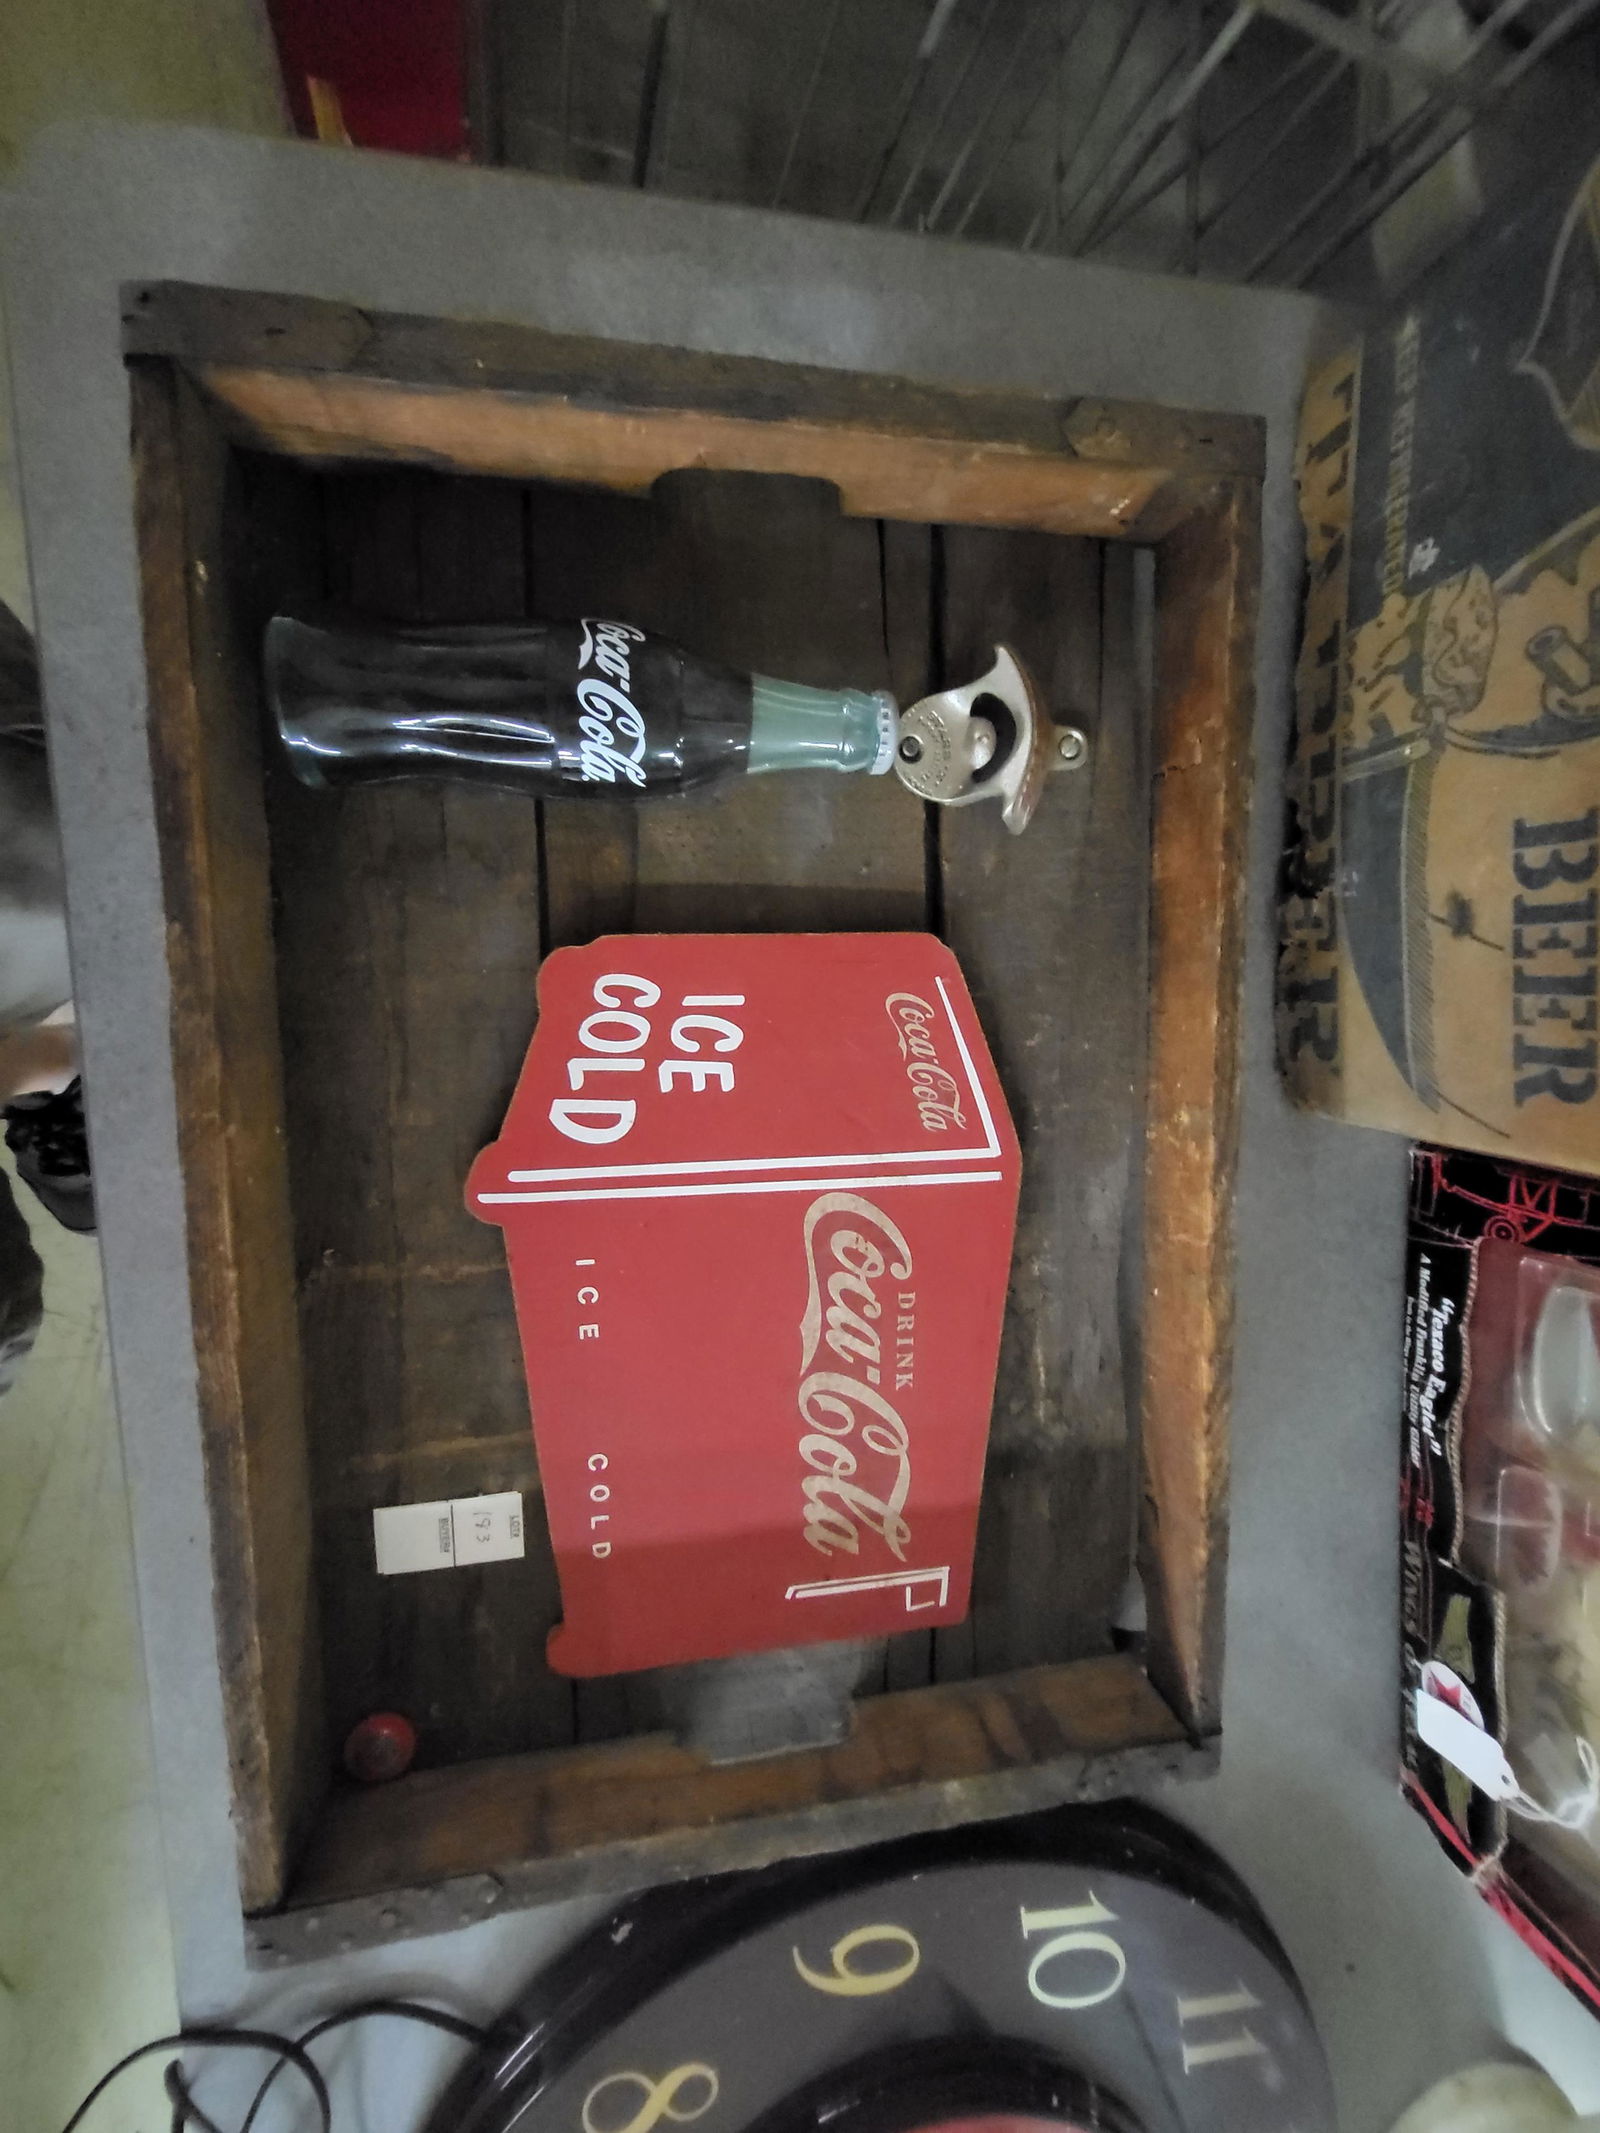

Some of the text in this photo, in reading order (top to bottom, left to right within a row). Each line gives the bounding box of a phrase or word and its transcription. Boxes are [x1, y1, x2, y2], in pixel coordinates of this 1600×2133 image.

[577, 618, 647, 788] Coca-Cola
[1514, 807, 1599, 1106] BEER
[549, 974, 662, 1145] COLD
[658, 994, 745, 1092] ICE
[885, 992, 968, 1133] Coca-Cola
[896, 1292, 915, 1390] DRINK
[1416, 1266, 1431, 1327] Modified
[799, 1192, 914, 1562] Coca-Cola
[1411, 1327, 1429, 1380] Franklin
[576, 1260, 612, 1557] ICE COLD
[792, 1923, 920, 1997] 9
[1019, 1889, 1127, 2010] 10
[1175, 1979, 1269, 2075] 11
[581, 2061, 720, 2133] 8
